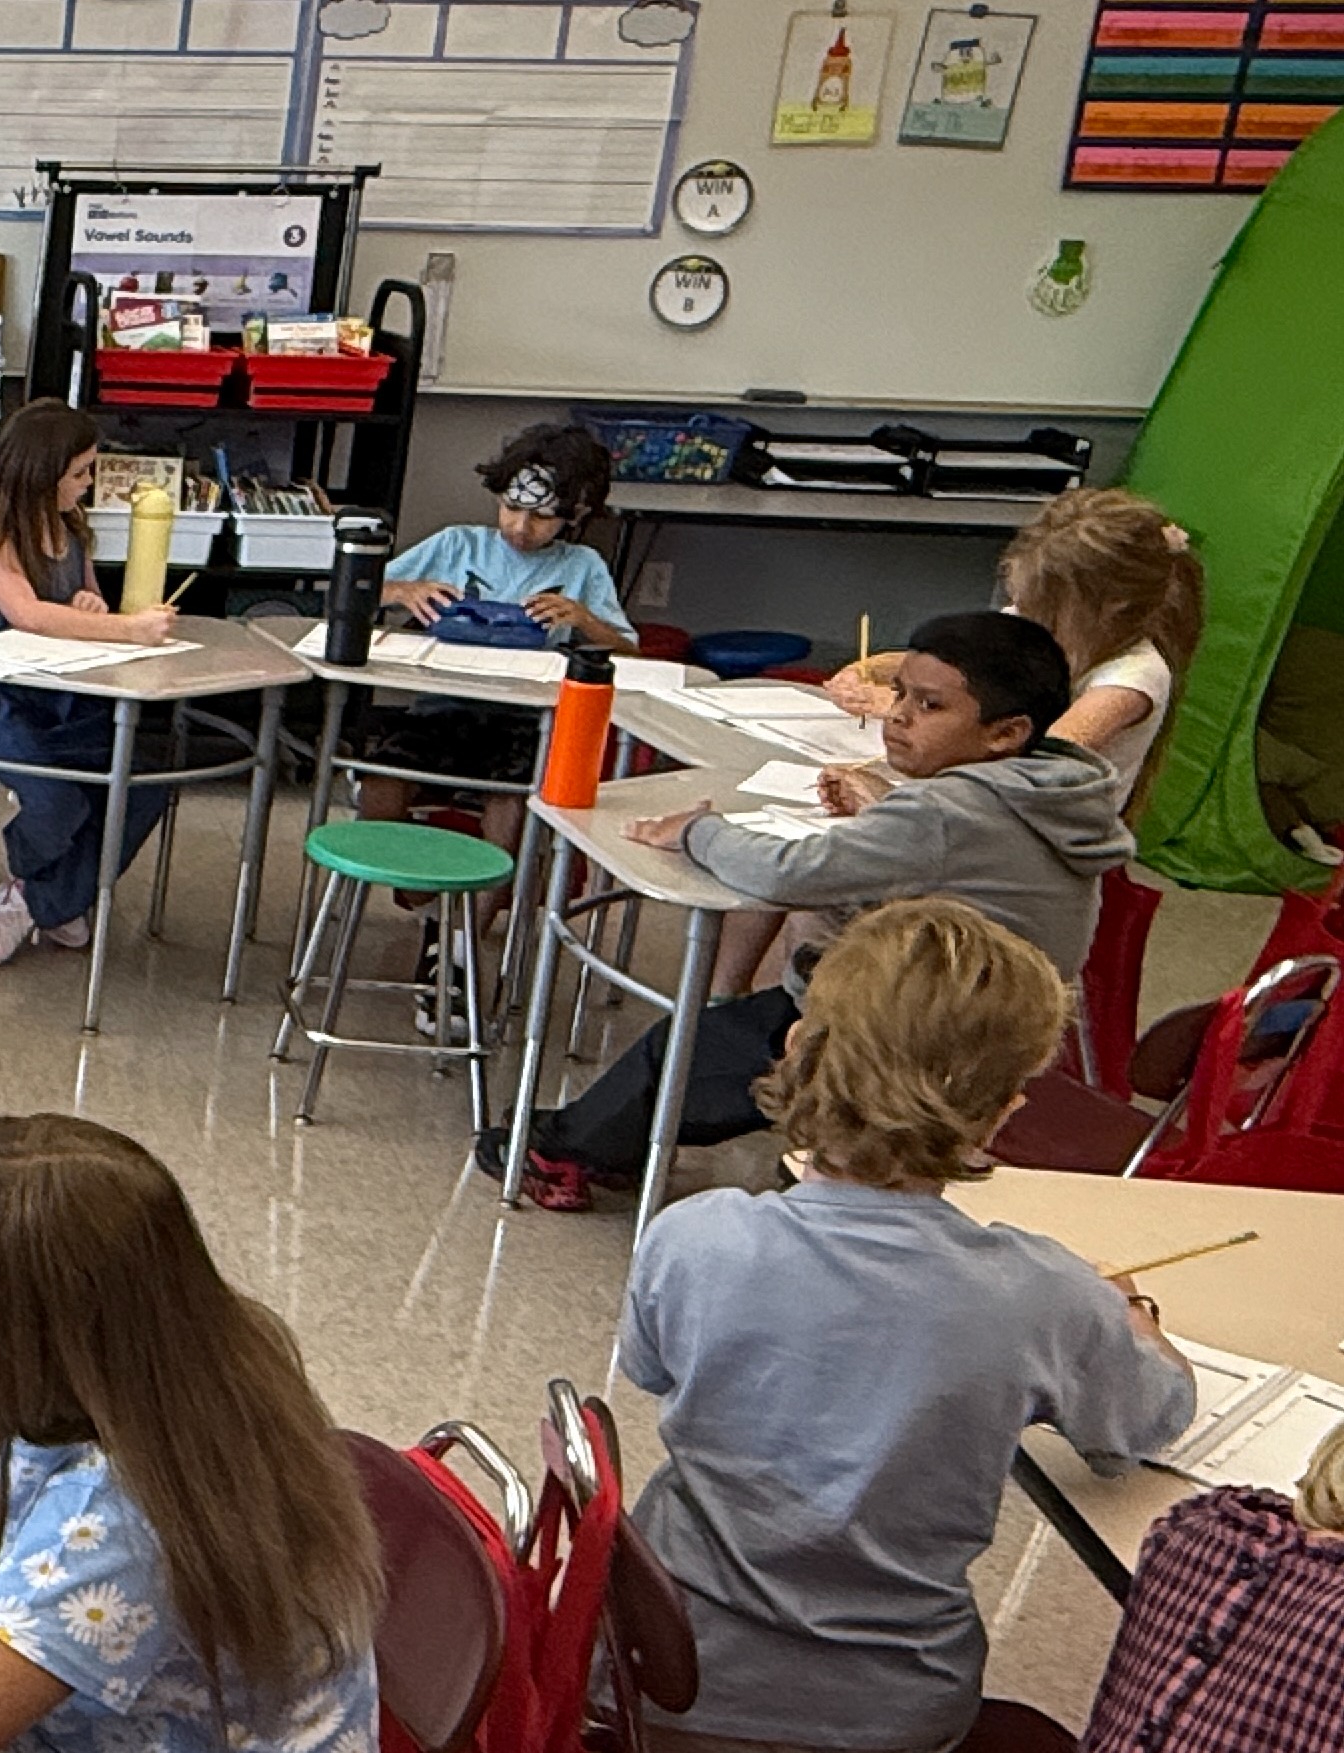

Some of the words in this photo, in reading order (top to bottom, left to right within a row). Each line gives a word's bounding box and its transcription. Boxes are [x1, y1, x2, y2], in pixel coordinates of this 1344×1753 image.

[696, 180, 733, 195] WIN
[707, 204, 720, 217] A
[84, 228, 130, 242] Vowel
[135, 228, 193, 243] Sounds
[675, 274, 711, 290] WIN
[683, 297, 694, 312] B
